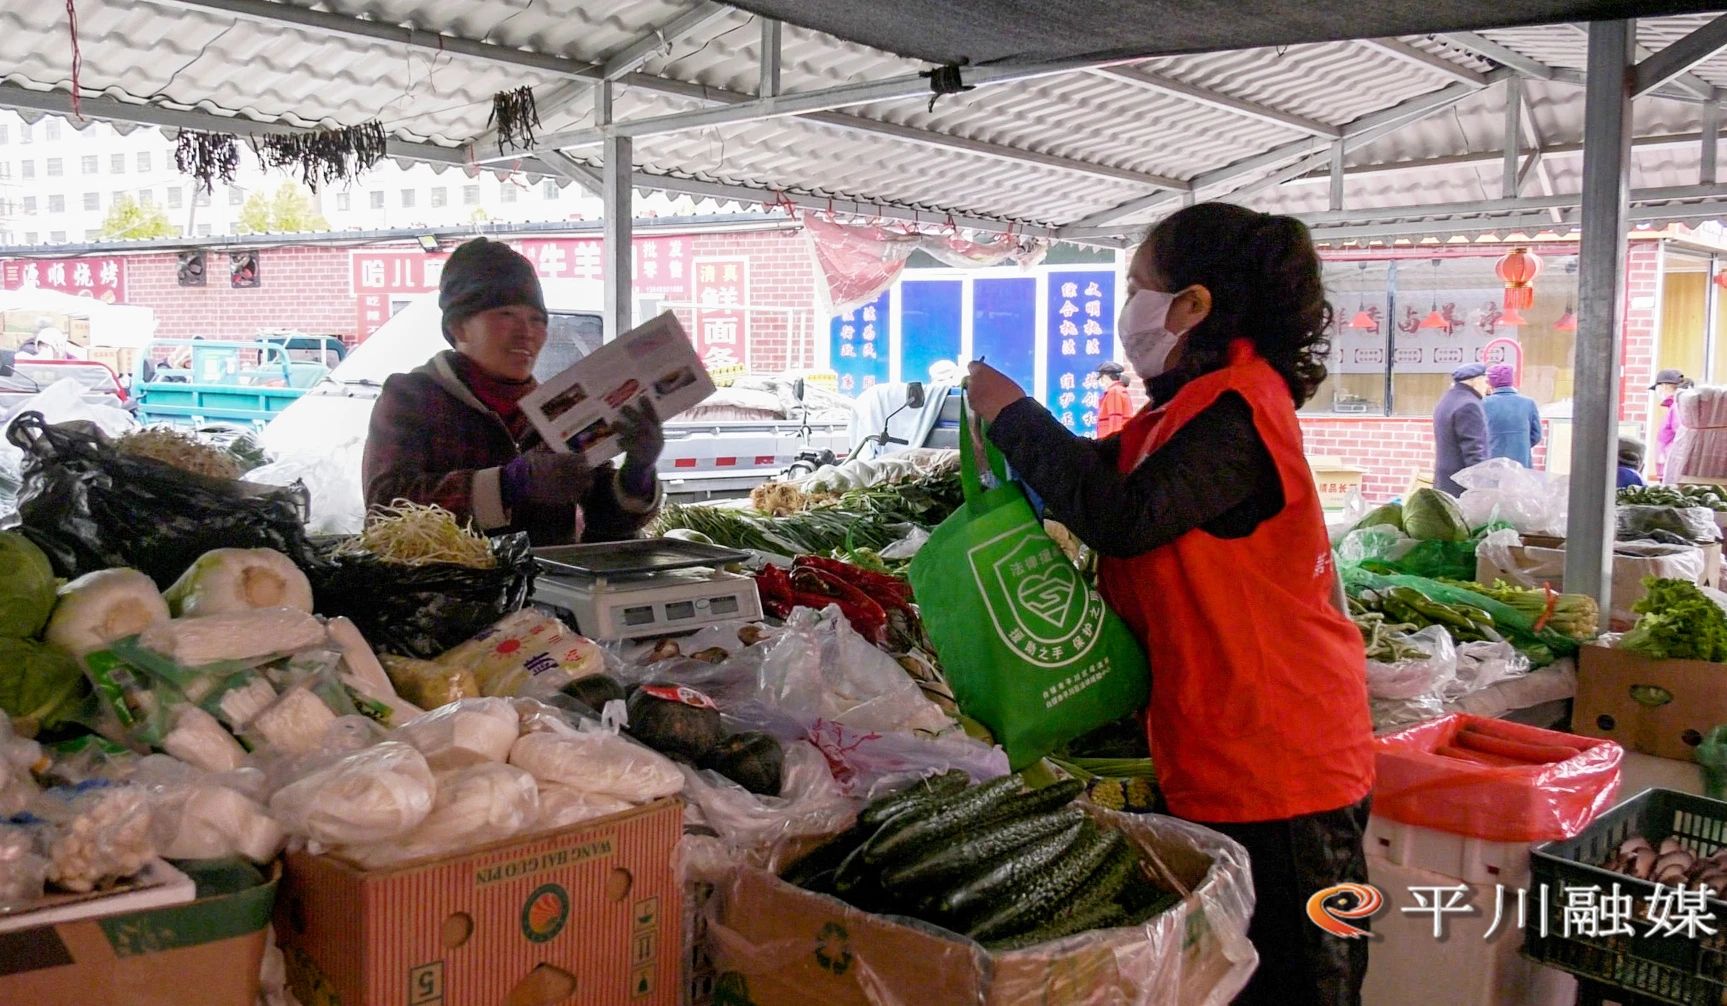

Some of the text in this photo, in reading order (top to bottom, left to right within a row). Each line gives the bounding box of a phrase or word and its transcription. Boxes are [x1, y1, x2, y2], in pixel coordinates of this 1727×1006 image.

[1059, 282, 1079, 355] 综合执法
[1083, 281, 1103, 355] 文明执法
[476, 840, 612, 885] WANG HAI GUO PIN
